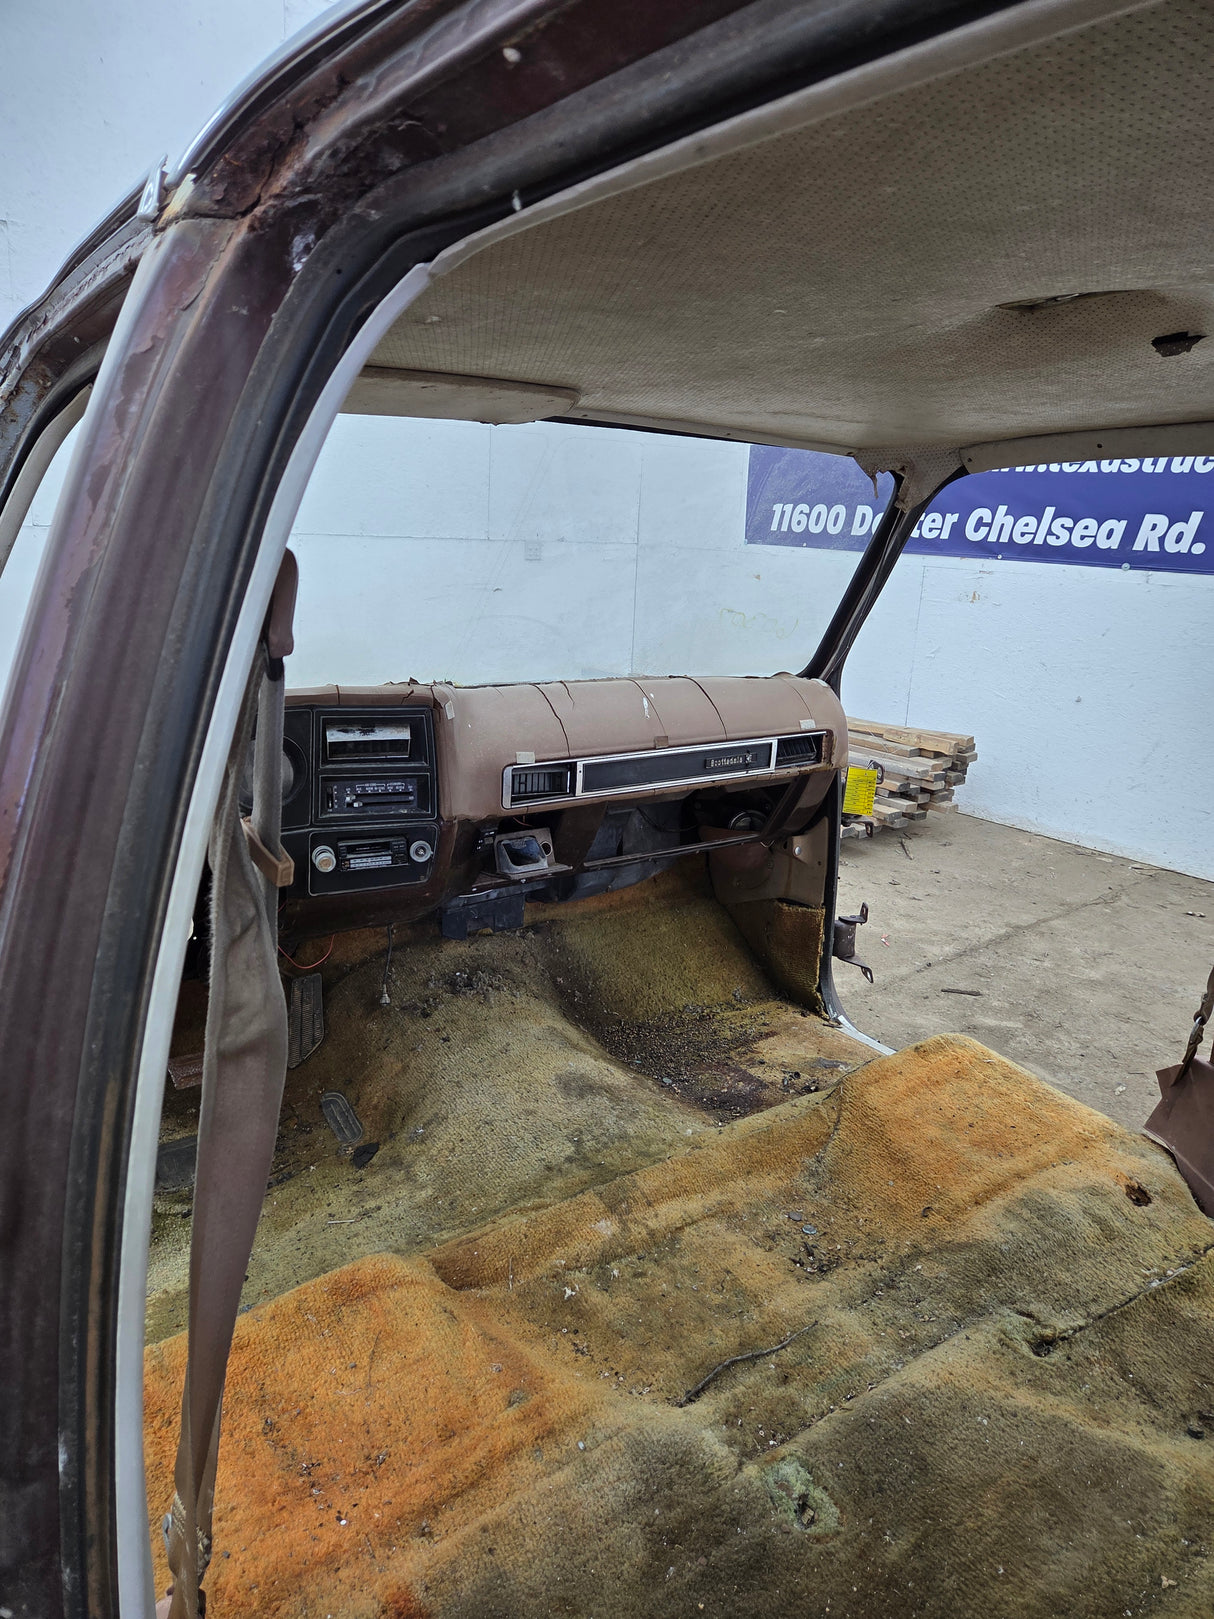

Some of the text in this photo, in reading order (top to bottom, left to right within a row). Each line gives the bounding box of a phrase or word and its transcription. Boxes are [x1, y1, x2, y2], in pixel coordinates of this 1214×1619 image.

[771, 503, 1207, 555] 11600 Dter Chelsea Rd.
